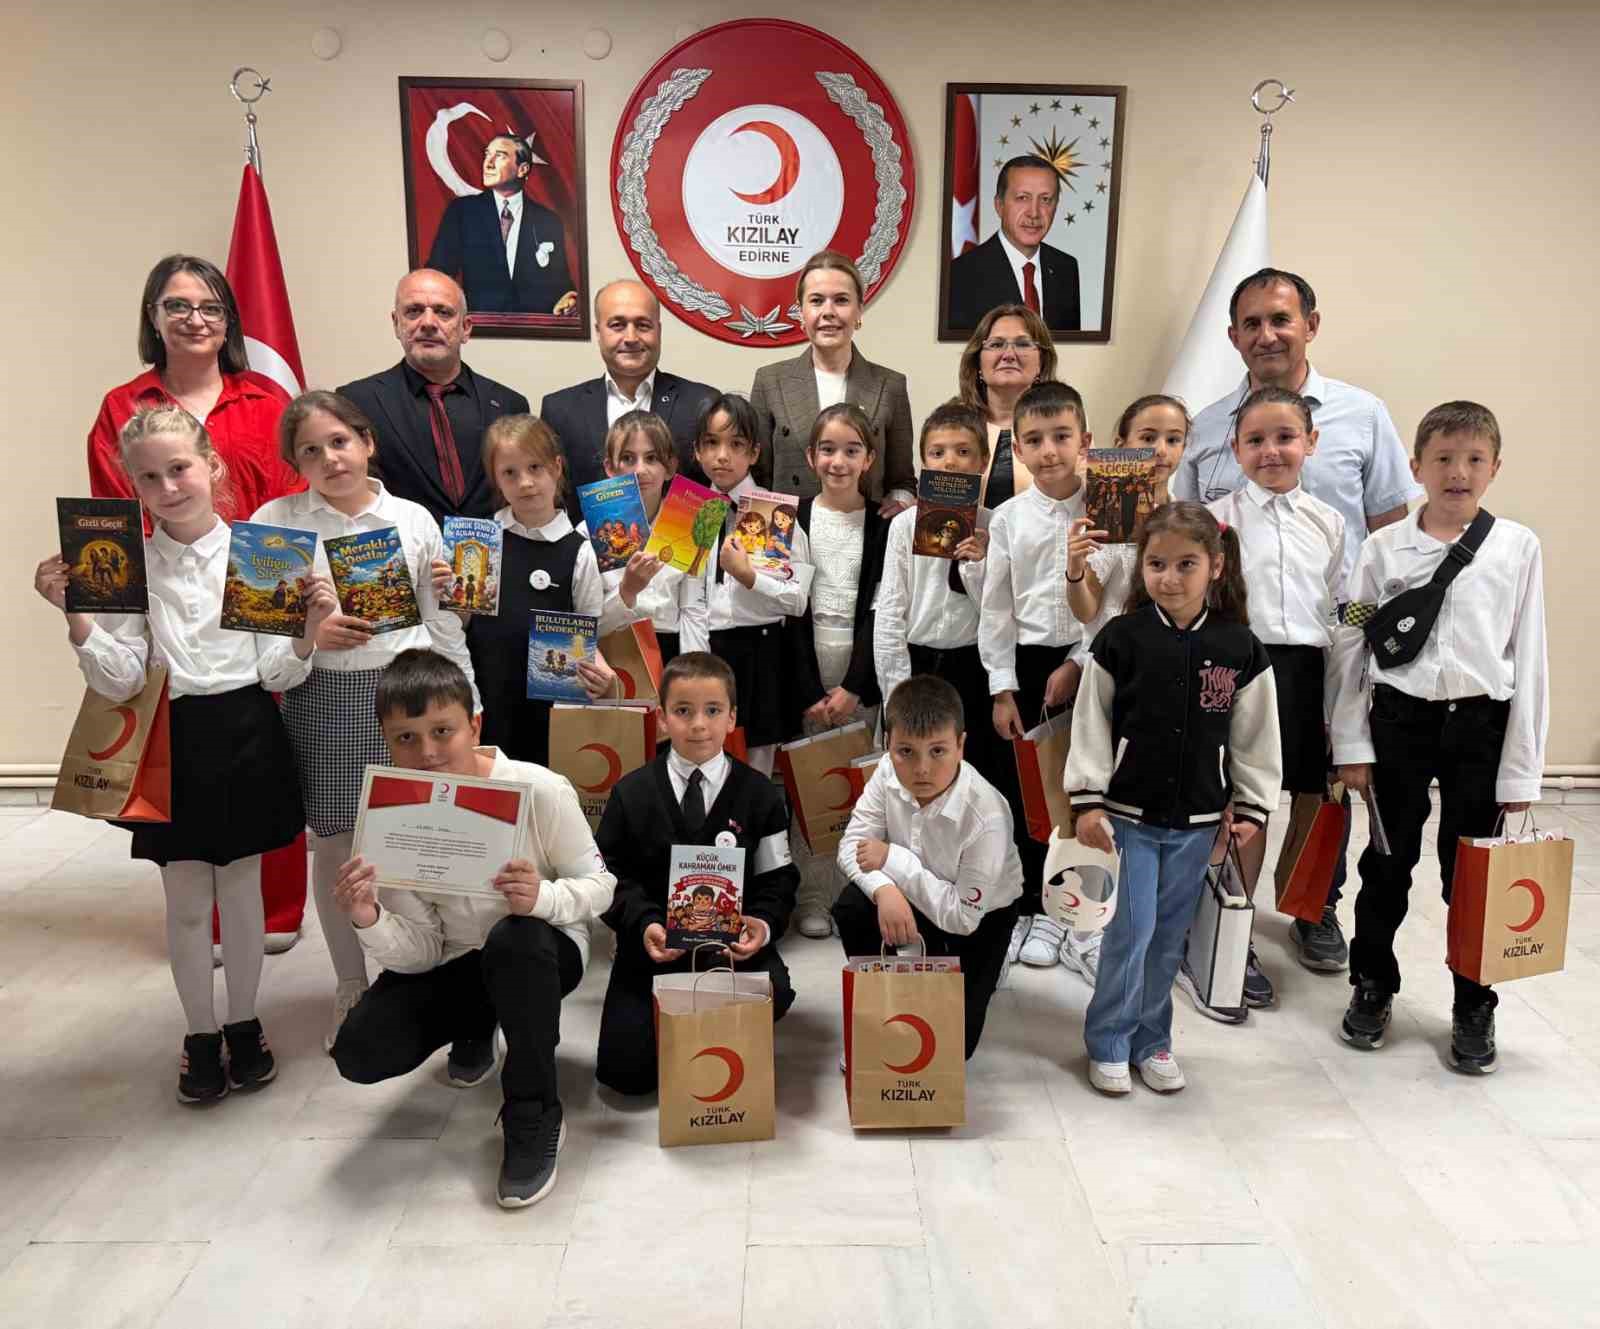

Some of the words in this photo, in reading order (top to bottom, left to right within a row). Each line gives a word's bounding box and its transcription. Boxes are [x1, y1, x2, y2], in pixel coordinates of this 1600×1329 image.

[748, 211, 780, 224] TÜRK
[727, 226, 799, 244] KIZILAY
[739, 248, 790, 262] EDİRNE
[78, 518, 100, 528] Gizli
[101, 519, 122, 530] Geçit
[340, 538, 388, 557] Meraklı
[344, 549, 388, 565] Dostlar
[535, 614, 595, 628] BULUTLARIN
[535, 621, 577, 634] İÇİNDEKİ
[1198, 665, 1242, 692] THINK
[74, 774, 111, 791] KIZILAY
[696, 852, 720, 862] KÜÇÜK
[679, 861, 716, 871] KAHRAMAN
[717, 861, 737, 872] ÖMER
[1515, 936, 1532, 945] TÜRK
[1503, 943, 1544, 959] KIZILAY
[897, 1079, 921, 1088] TÜRK
[881, 1089, 936, 1101] KIZILAY
[706, 1105, 731, 1114] TÜRK
[689, 1111, 746, 1128] KIZILAY
